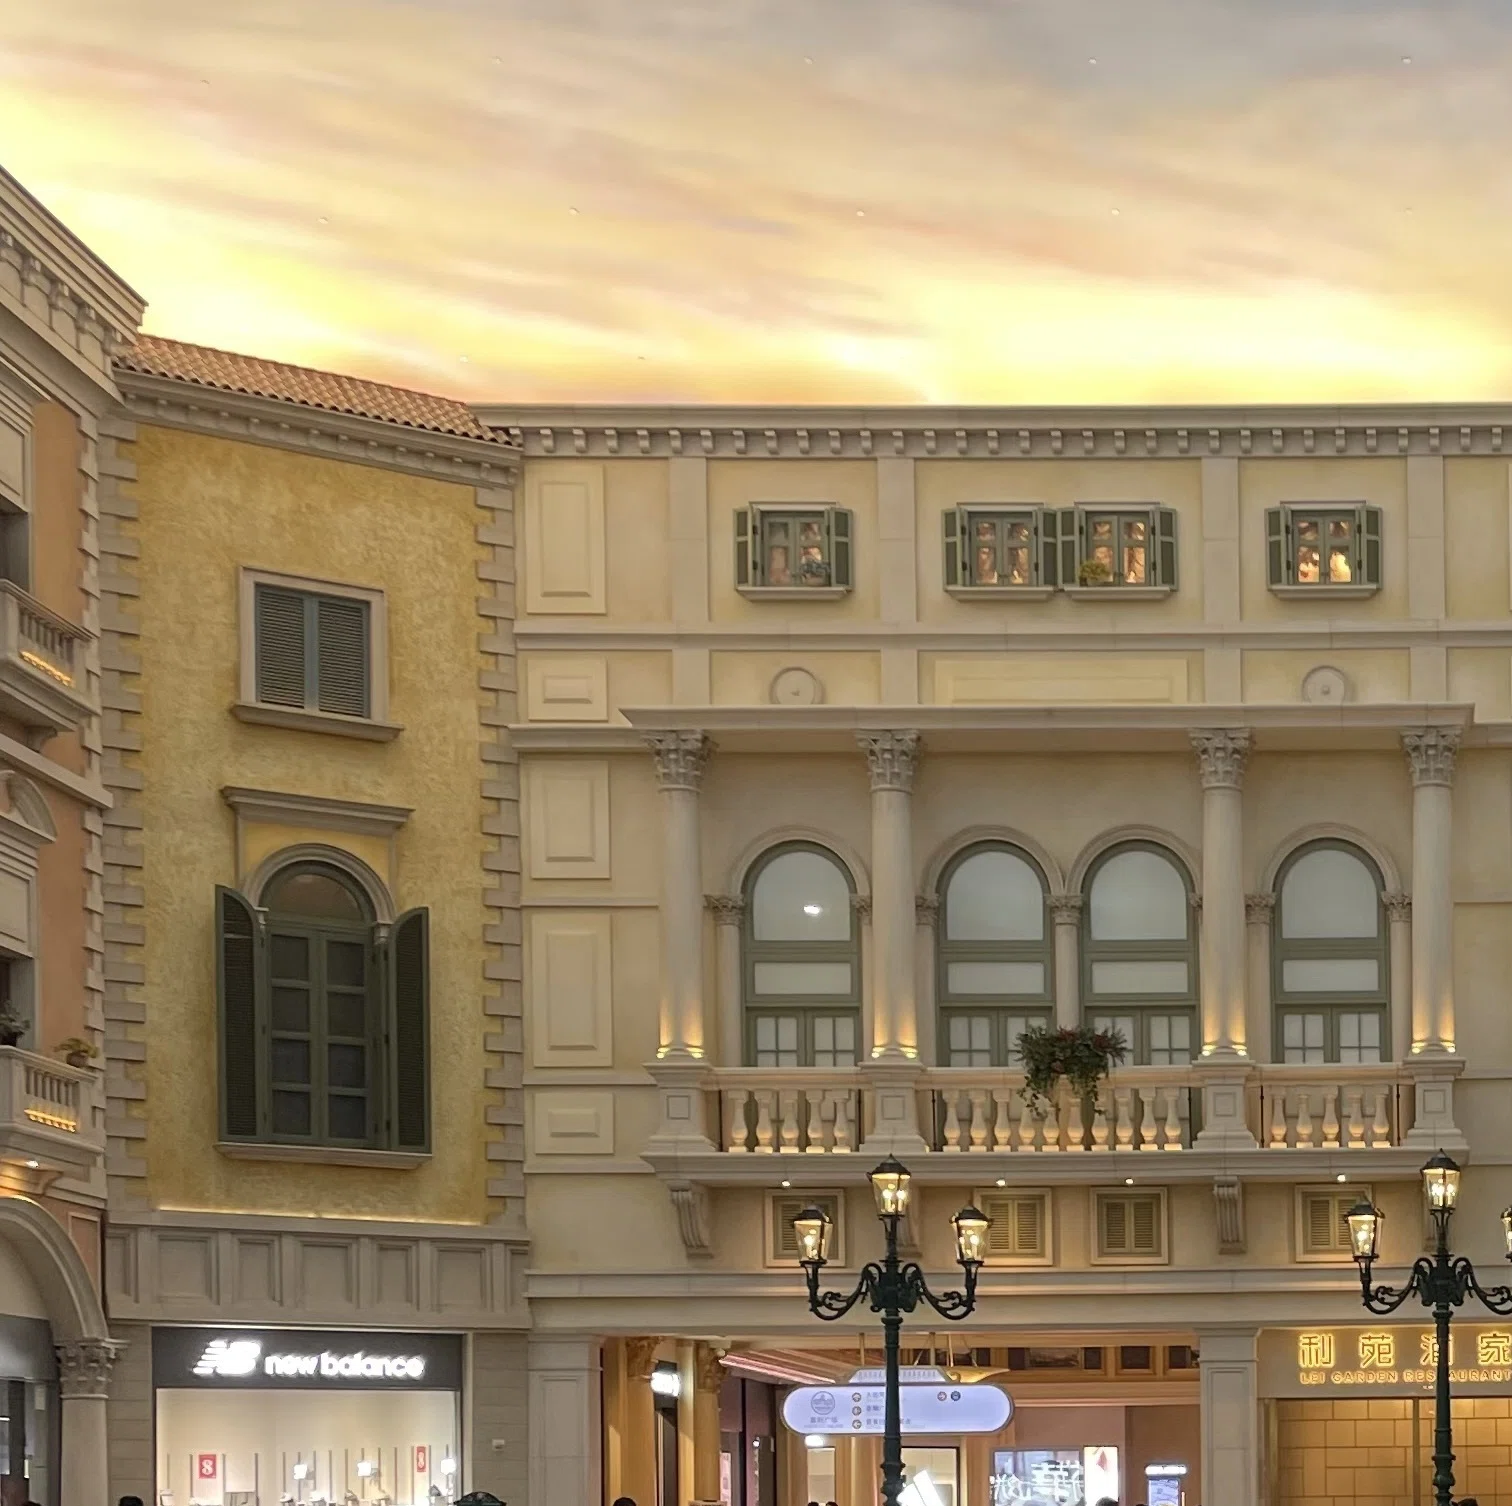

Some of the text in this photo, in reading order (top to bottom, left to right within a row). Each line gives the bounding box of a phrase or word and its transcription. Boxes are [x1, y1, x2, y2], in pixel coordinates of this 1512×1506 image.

[264, 1351, 425, 1377] new balance
[1300, 1368, 1512, 1384] LEI GARDEN RESAURANT
